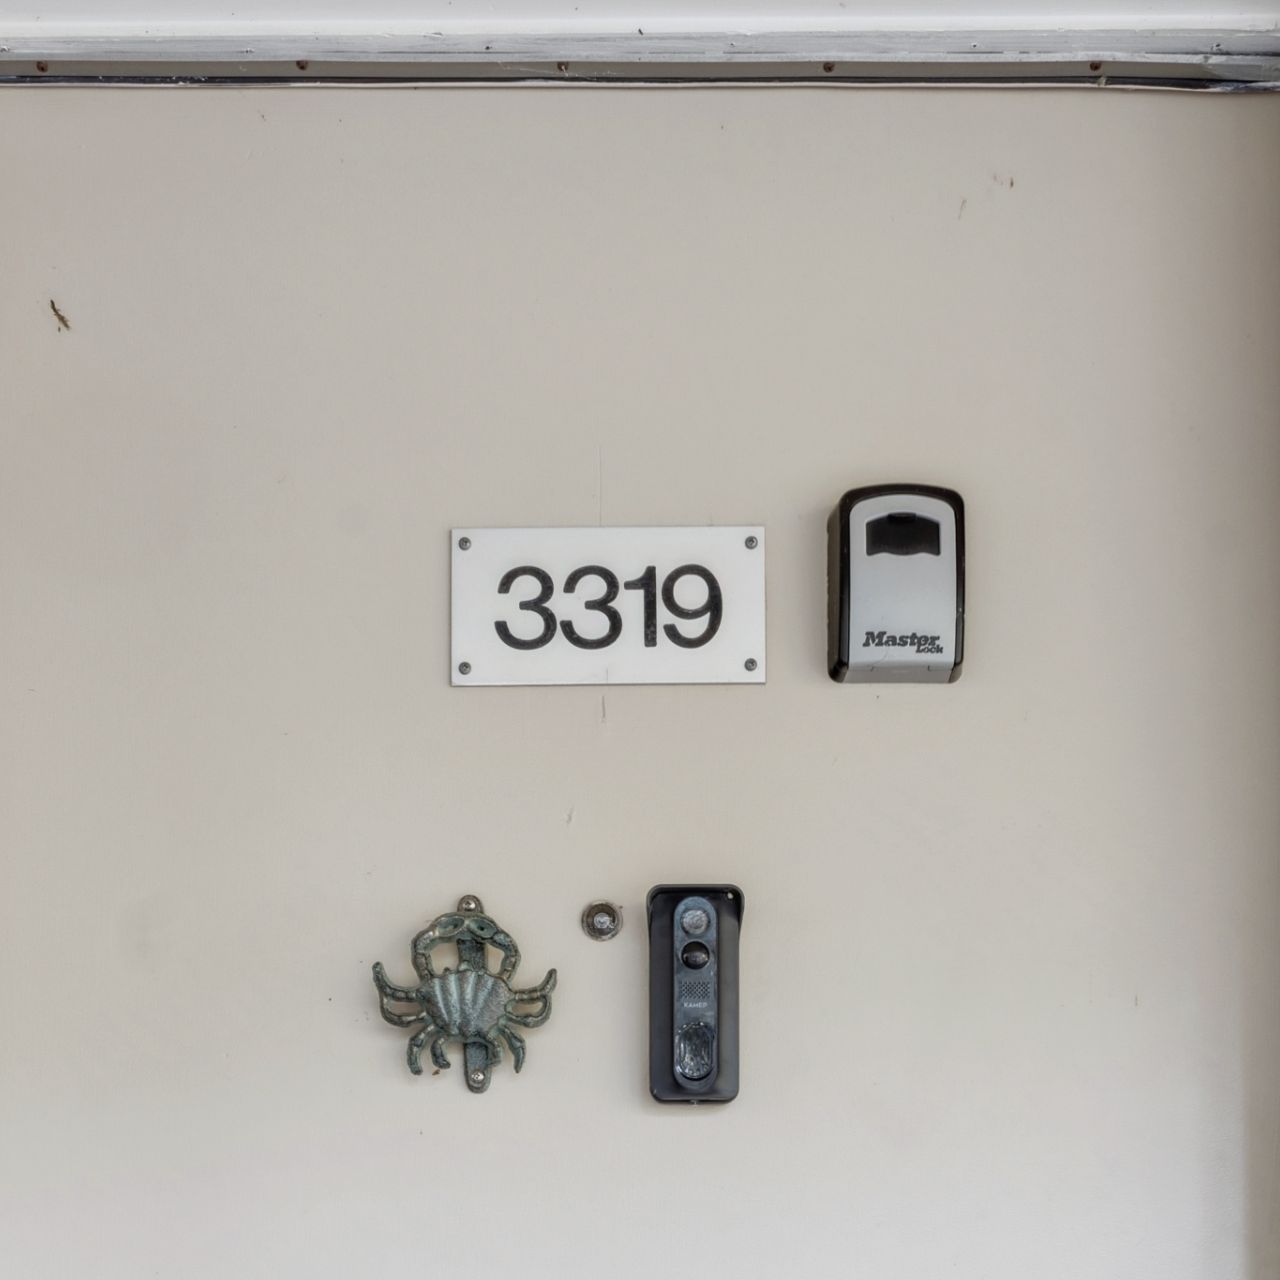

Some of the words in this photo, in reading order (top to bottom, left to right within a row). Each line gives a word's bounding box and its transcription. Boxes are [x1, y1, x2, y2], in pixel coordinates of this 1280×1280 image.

[494, 564, 723, 650] 3319
[862, 631, 940, 647] Master
[915, 645, 944, 654] Lock
